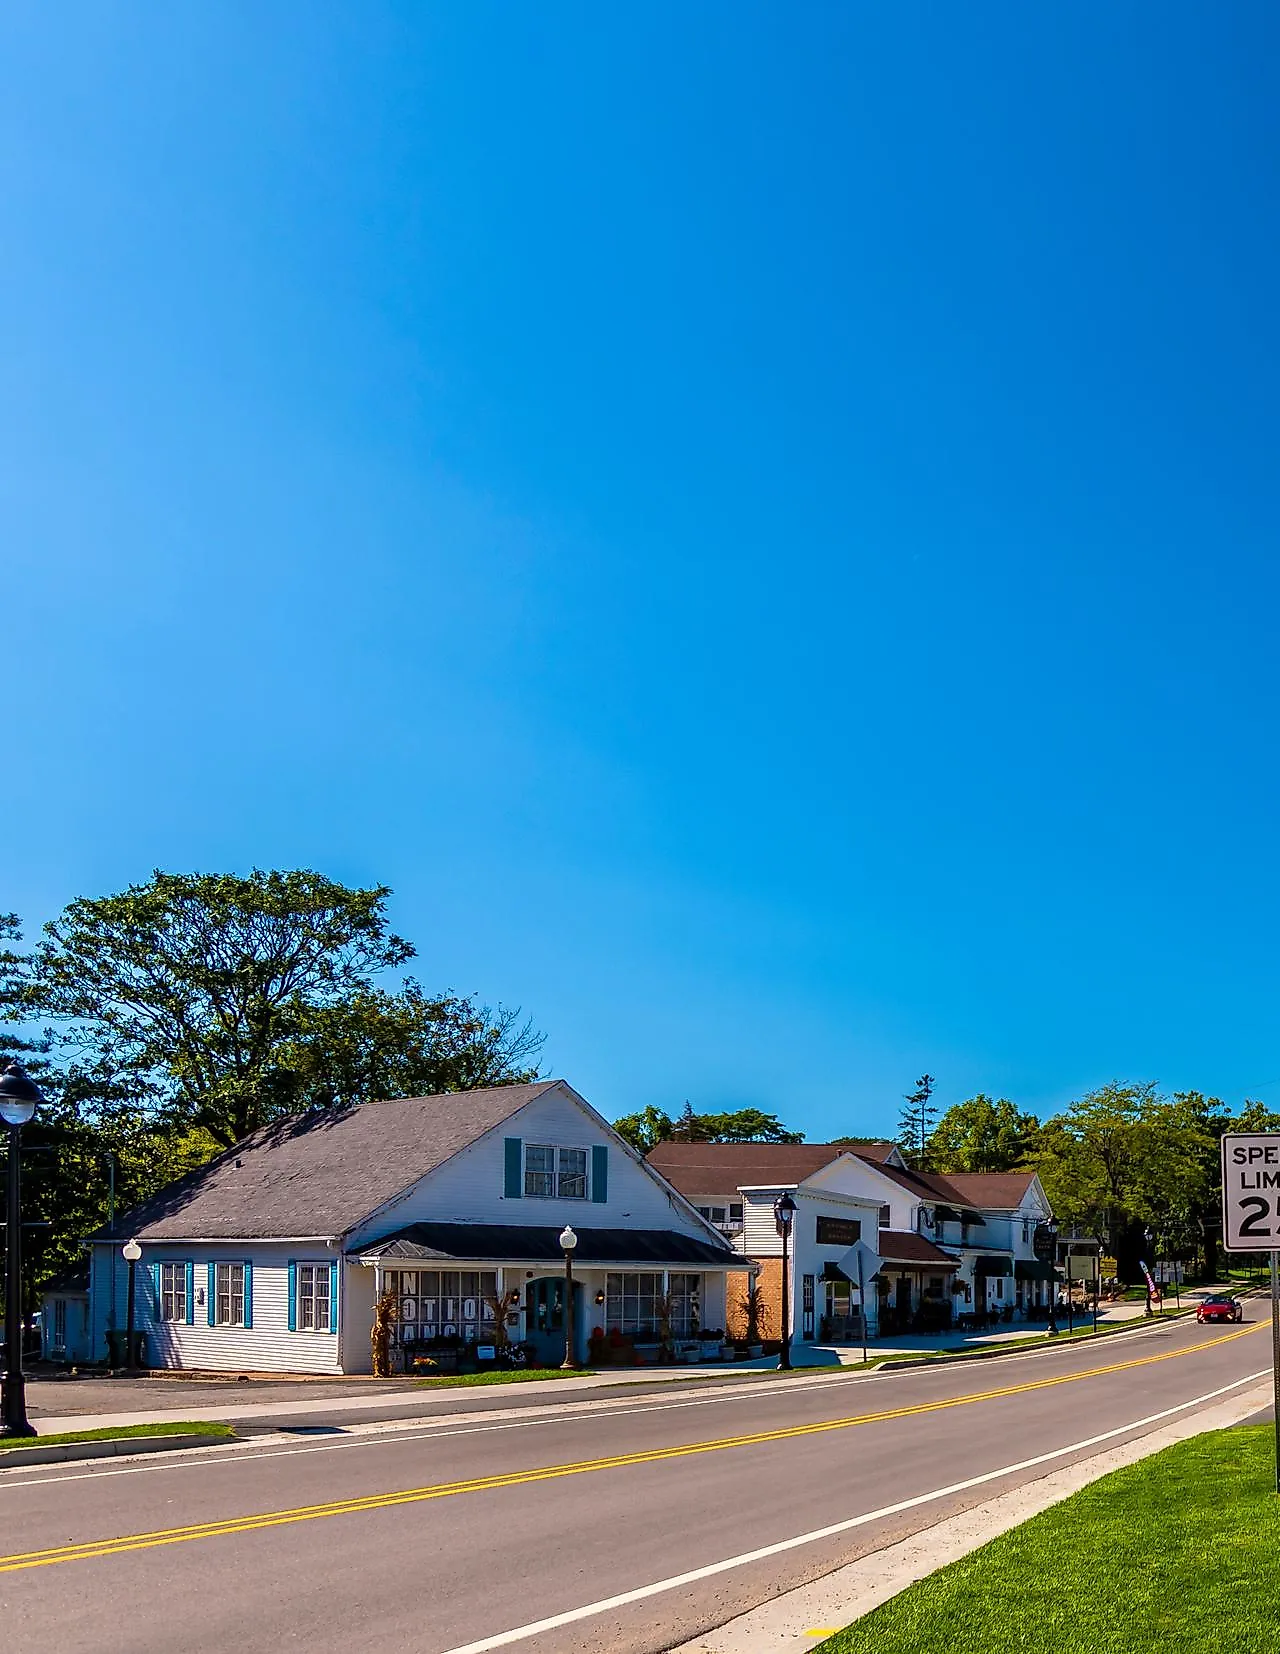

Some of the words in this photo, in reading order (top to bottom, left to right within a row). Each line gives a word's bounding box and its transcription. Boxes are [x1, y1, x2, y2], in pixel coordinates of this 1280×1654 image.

[385, 1272, 417, 1295] IN
[402, 1298, 496, 1321] OTION
[389, 1325, 475, 1344] ANCE
